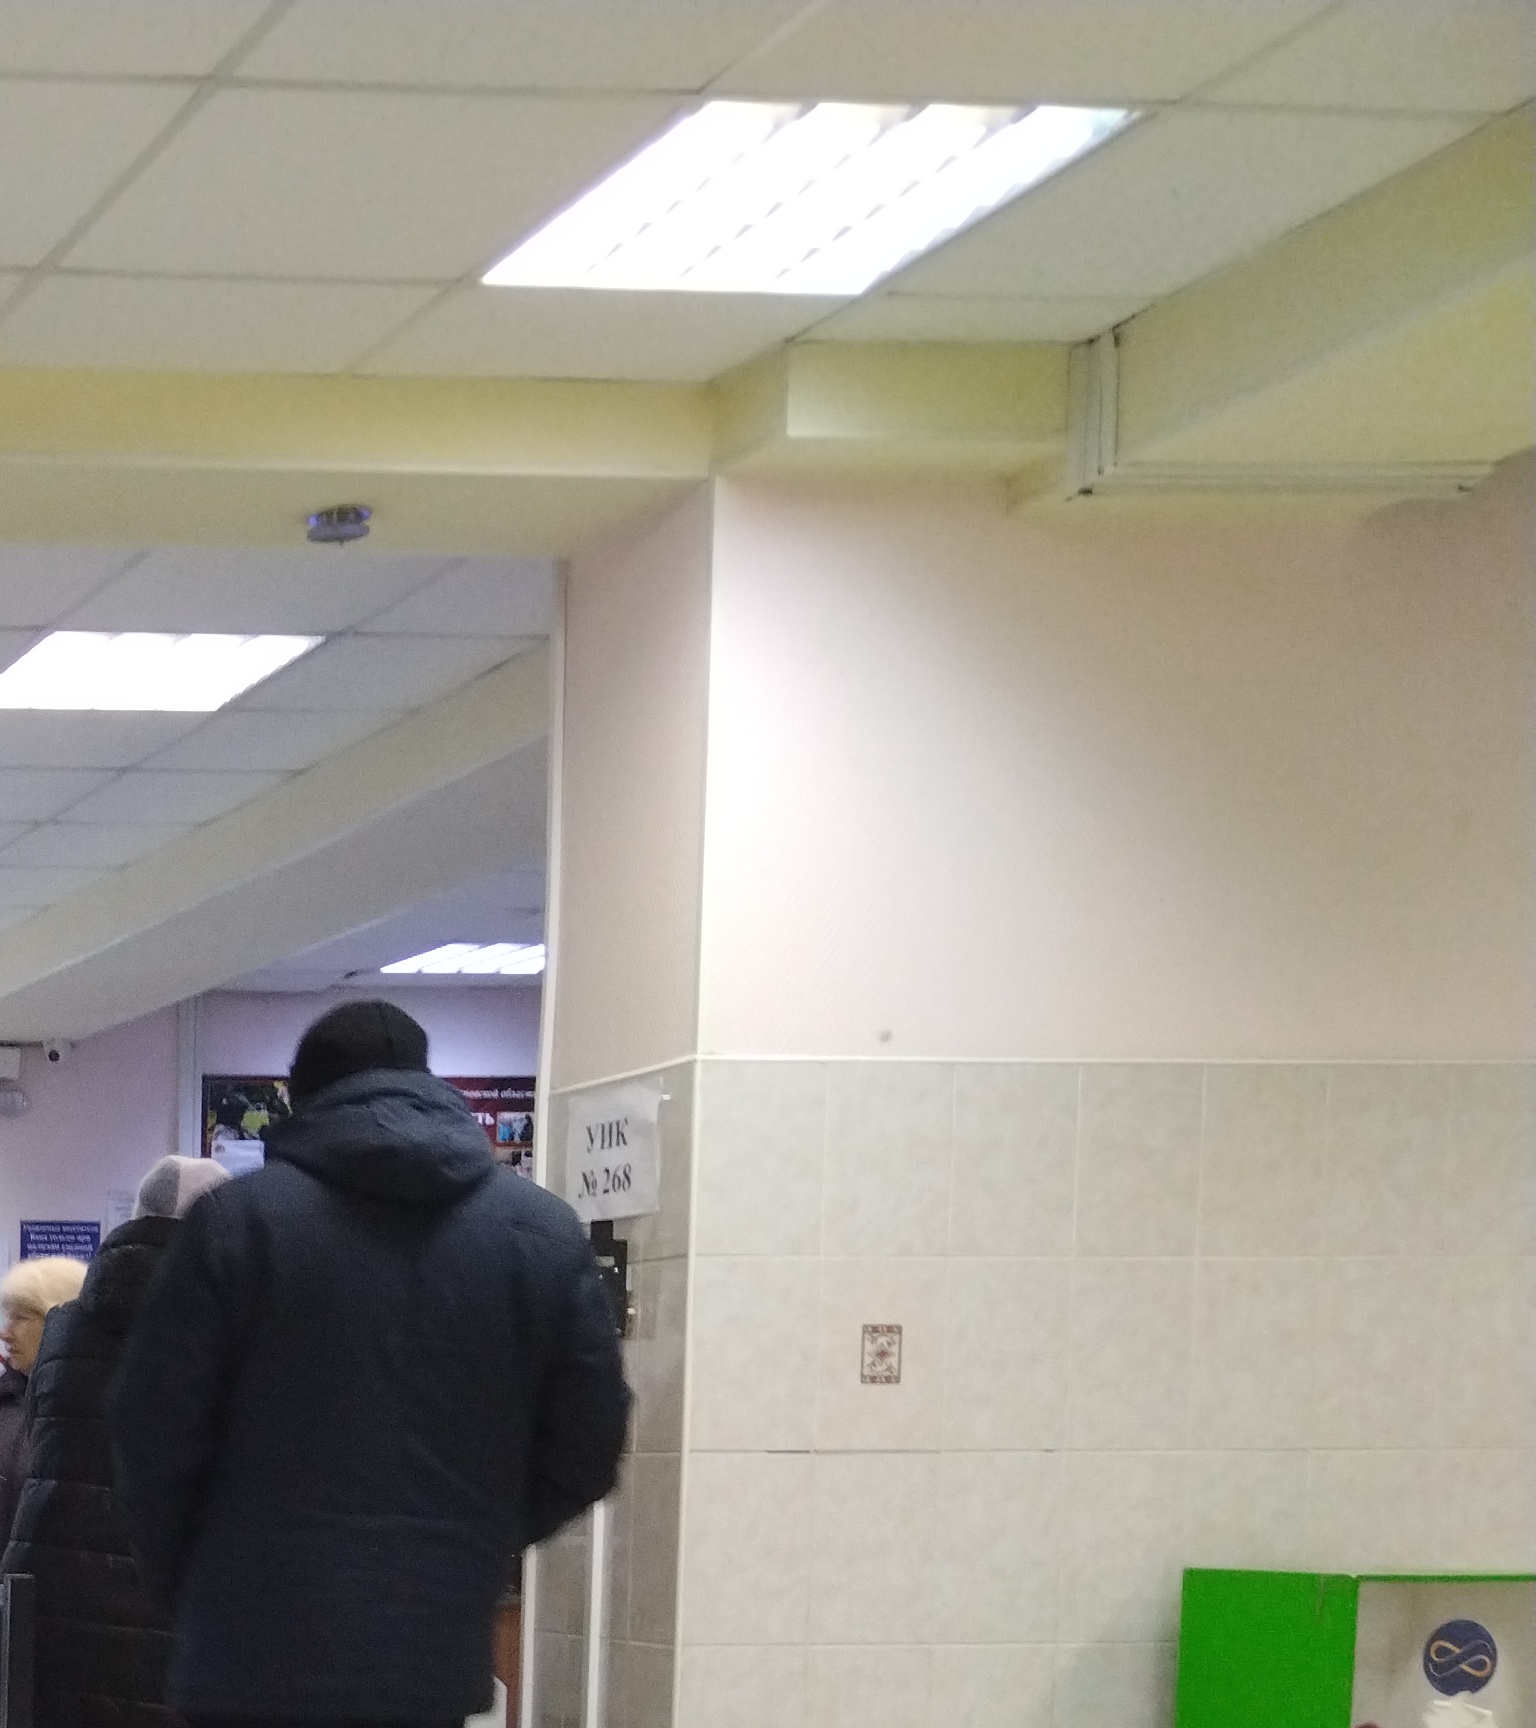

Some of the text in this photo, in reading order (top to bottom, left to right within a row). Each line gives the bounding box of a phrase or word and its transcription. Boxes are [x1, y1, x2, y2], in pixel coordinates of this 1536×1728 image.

[586, 1117, 629, 1154] УИК
[578, 1162, 632, 1199] № 268
